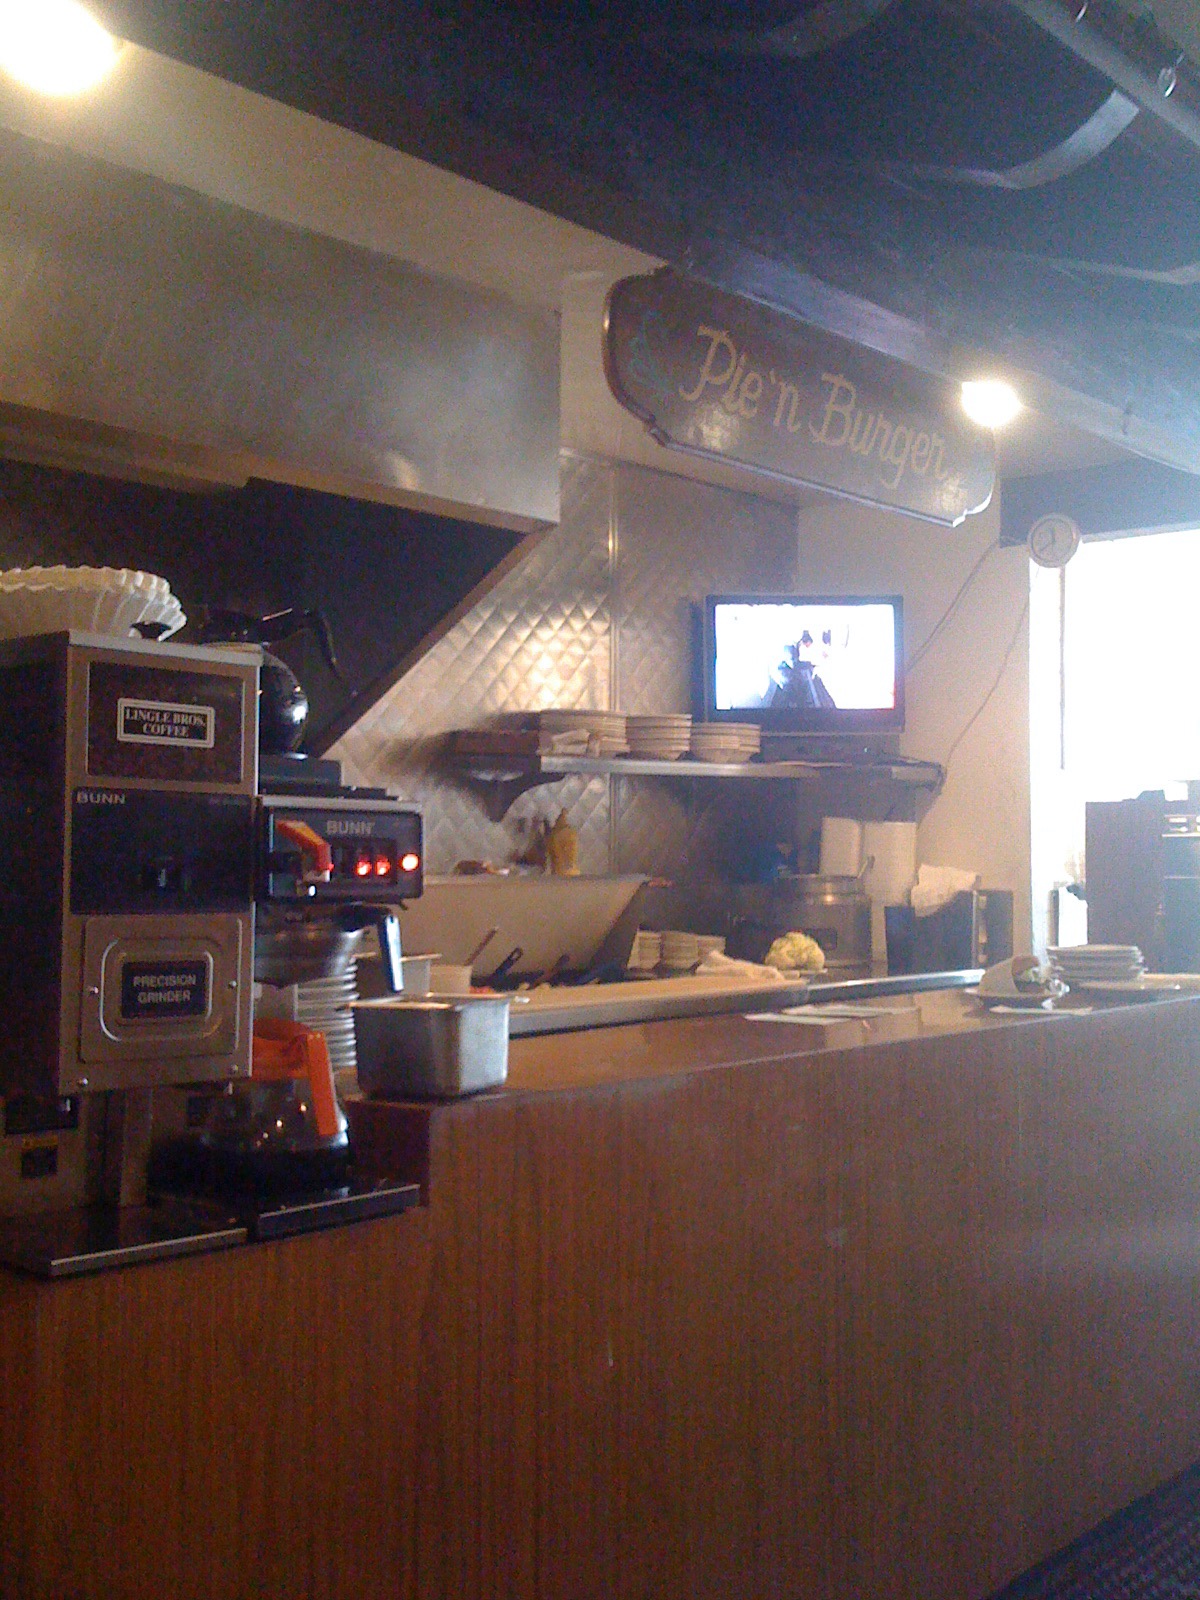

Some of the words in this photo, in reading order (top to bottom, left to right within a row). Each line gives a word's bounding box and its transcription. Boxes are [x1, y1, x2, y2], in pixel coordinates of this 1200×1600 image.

[808, 371, 948, 490] Burger
[125, 707, 171, 723] LINGLE
[142, 721, 189, 738] COFFEE
[76, 791, 126, 805] BUNN
[326, 820, 375, 835] BUNN
[133, 973, 197, 988] PRECISION
[137, 989, 191, 1004] GRINDER
